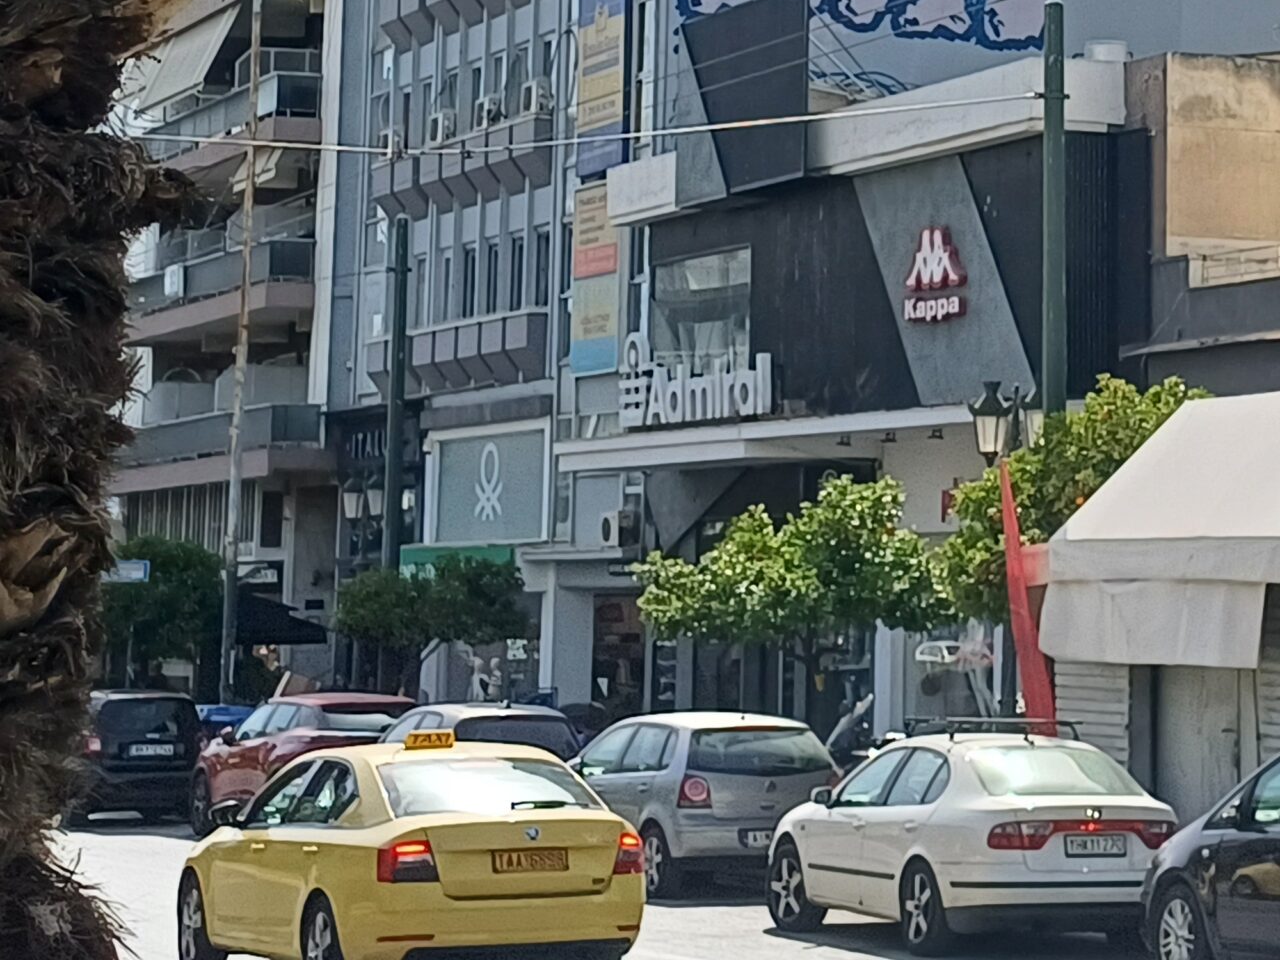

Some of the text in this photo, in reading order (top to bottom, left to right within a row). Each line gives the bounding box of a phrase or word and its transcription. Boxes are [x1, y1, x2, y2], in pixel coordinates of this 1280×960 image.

[904, 296, 960, 322] Kappa
[646, 352, 771, 425] Admiral
[411, 732, 451, 746] TAXI
